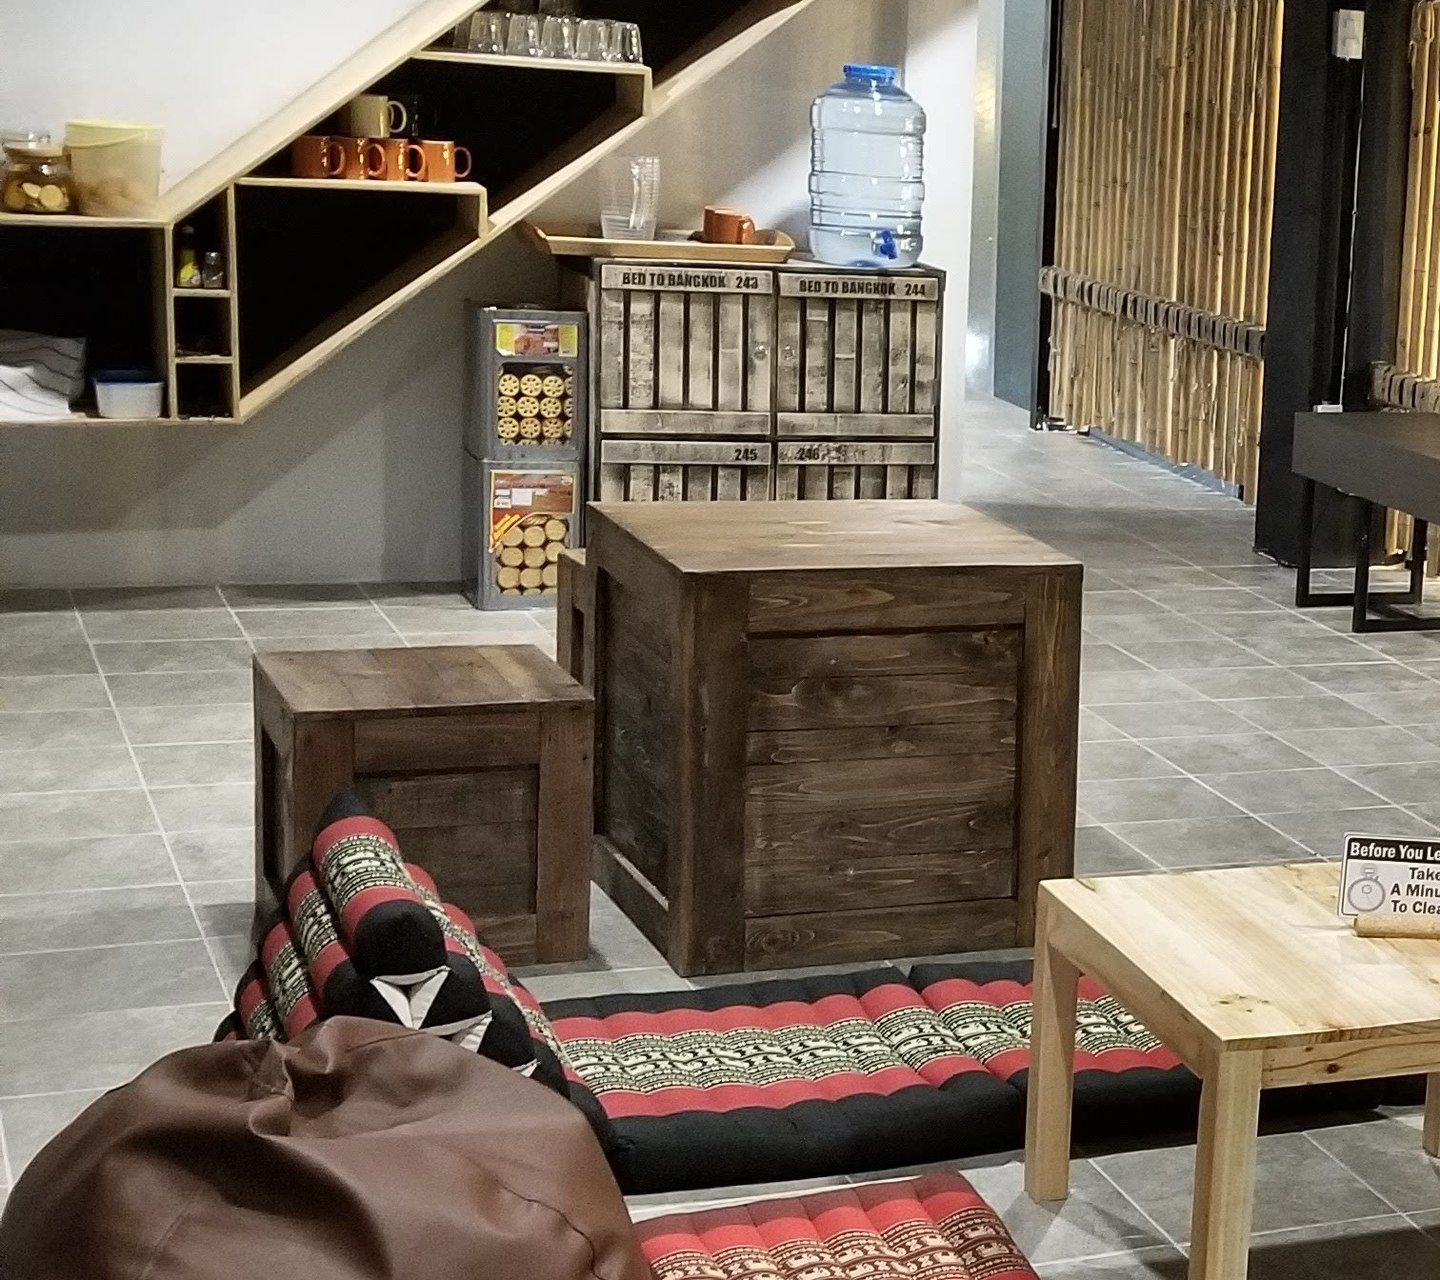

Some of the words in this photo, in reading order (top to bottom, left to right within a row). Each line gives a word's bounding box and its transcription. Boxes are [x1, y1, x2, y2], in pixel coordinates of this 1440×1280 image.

[622, 272, 646, 285] BED
[650, 272, 664, 286] TO
[668, 273, 726, 288] BANGKOK
[735, 276, 758, 289] 243
[799, 280, 821, 293] BED
[824, 281, 838, 294] TO
[842, 281, 896, 296] BANGKOK
[904, 283, 926, 296] 244
[734, 448, 758, 462] 245
[1350, 842, 1396, 858] Before
[1398, 844, 1423, 860] You
[1390, 883, 1401, 896] A
[1391, 900, 1407, 913] To
